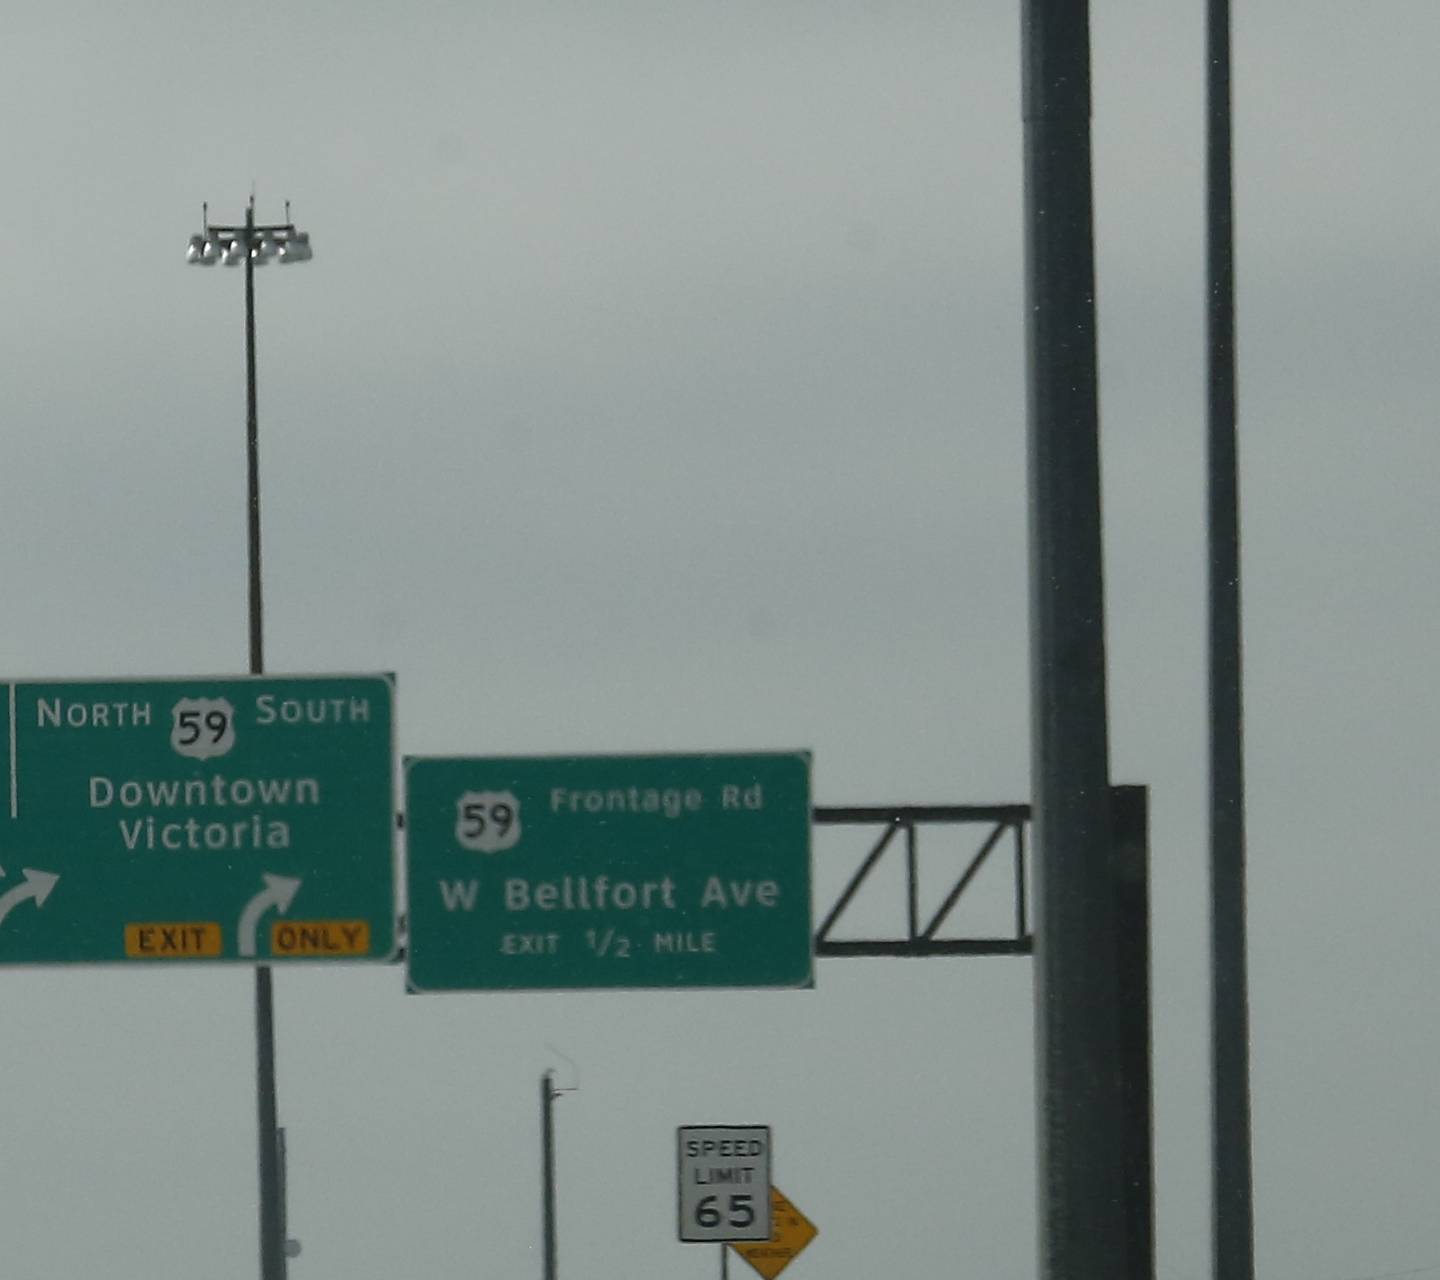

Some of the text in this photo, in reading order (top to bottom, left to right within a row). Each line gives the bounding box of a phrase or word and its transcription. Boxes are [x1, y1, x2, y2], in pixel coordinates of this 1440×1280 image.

[36, 692, 371, 745] NORTH 59 SOUTH
[89, 773, 319, 810] Downtown
[462, 783, 763, 840] 59 Frontage Rd
[121, 815, 291, 850] Victoria
[439, 876, 780, 911] W Bellfort Ave
[135, 925, 364, 953] EXIT ONLY
[500, 932, 559, 955] EXIT
[655, 932, 717, 952] MILE
[687, 1141, 762, 1157] SPEED
[695, 1168, 754, 1184] LIMIT
[695, 1195, 755, 1228] 65
